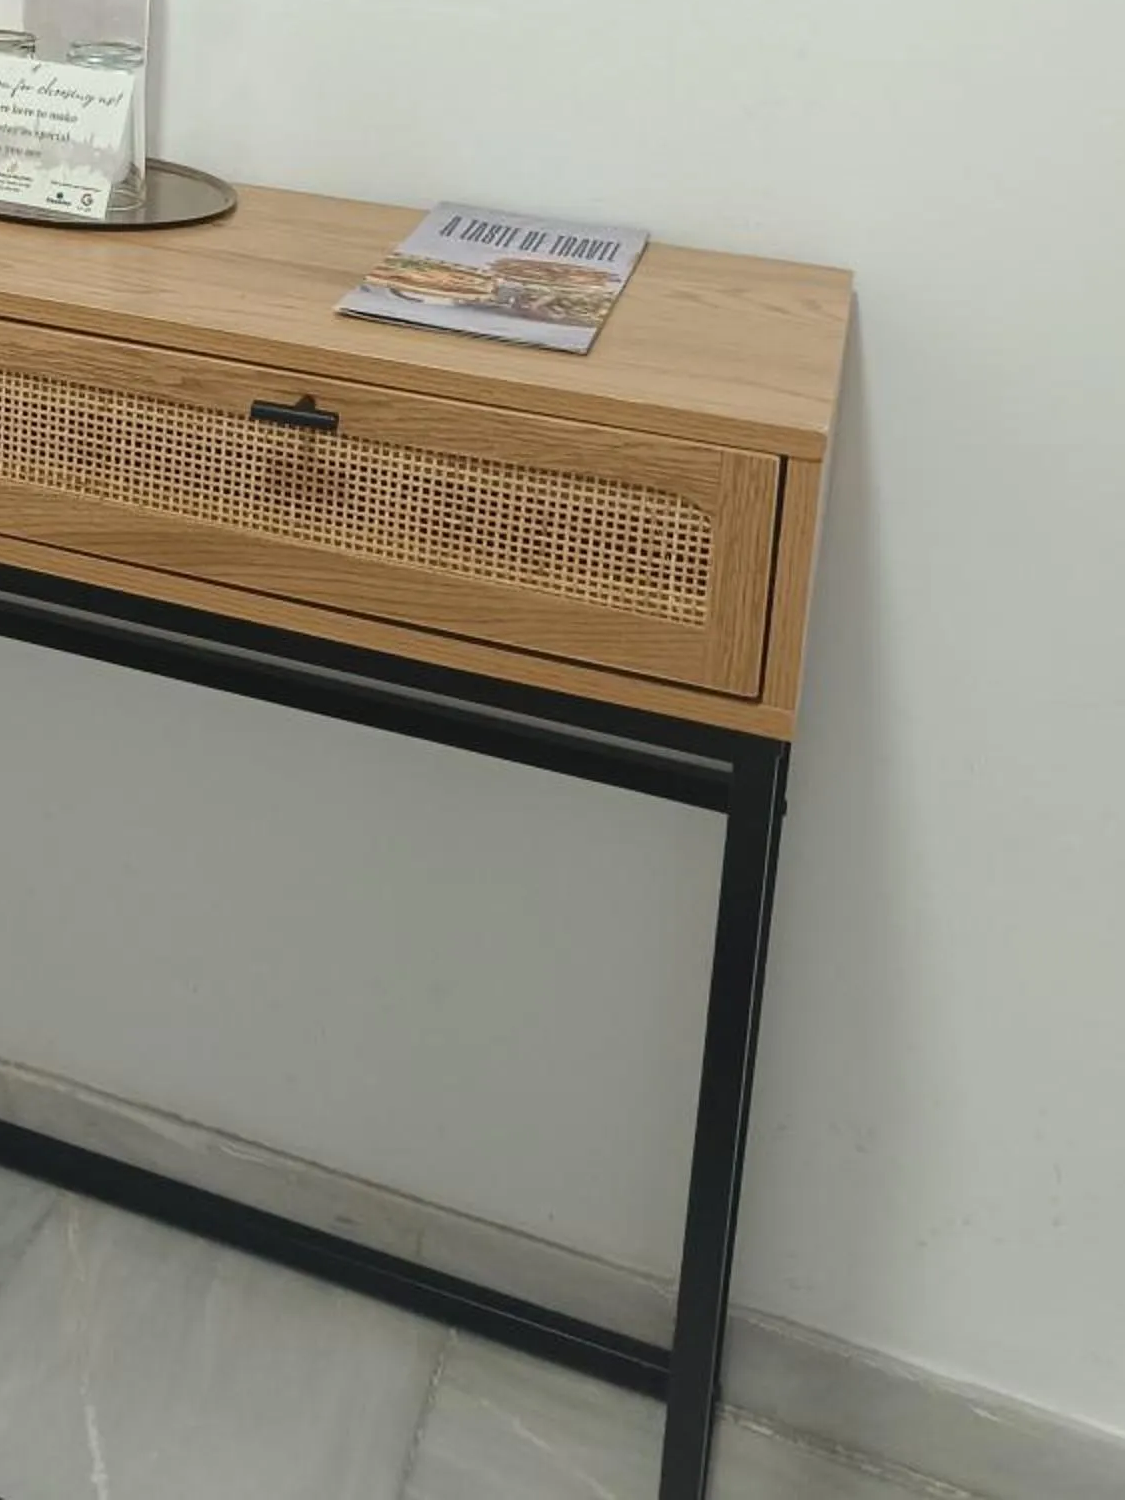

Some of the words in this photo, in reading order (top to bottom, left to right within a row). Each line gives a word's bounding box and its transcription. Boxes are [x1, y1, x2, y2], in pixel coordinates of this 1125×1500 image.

[11, 103, 36, 117] here
[36, 108, 48, 119] to
[440, 214, 463, 237] A
[462, 218, 517, 249] TASTE
[518, 230, 547, 252] OF
[549, 233, 622, 263] TRAVEL
